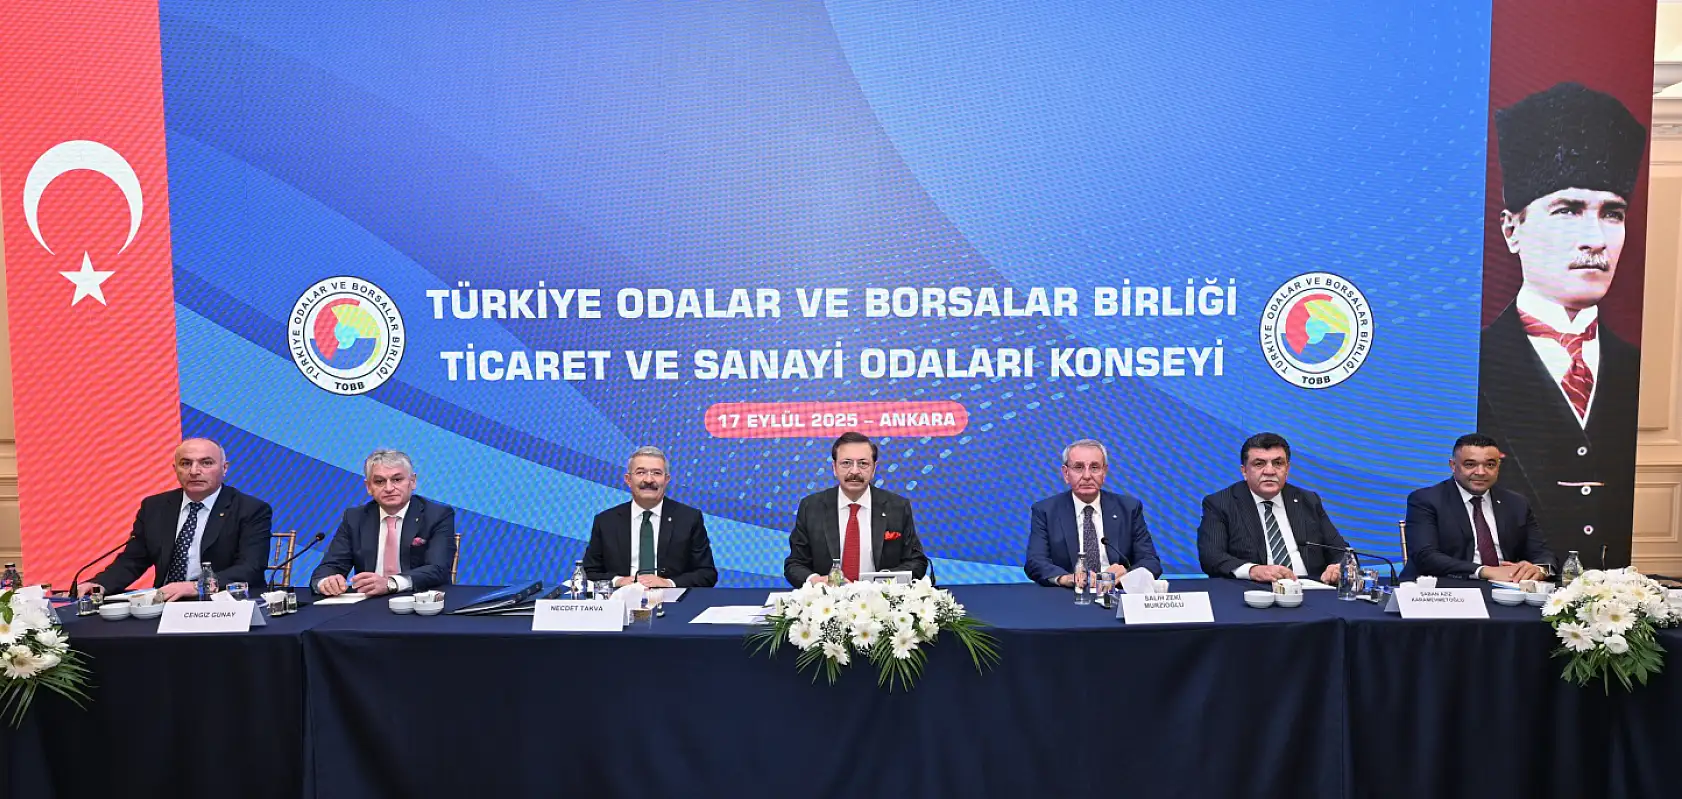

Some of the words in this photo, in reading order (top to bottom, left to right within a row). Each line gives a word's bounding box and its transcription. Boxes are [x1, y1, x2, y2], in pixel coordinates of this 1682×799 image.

[294, 286, 328, 325] ODALAR
[331, 281, 346, 290] VE
[352, 282, 400, 331] BORSALAR
[427, 280, 602, 320] TÜRKİYE
[618, 287, 781, 319] ODALAR
[796, 288, 850, 319] VE
[867, 287, 1079, 319] BORSALAR
[1095, 278, 1238, 317] BİRLİĞİ
[1267, 281, 1302, 320] ODALAR
[1305, 276, 1321, 285] VE
[1325, 277, 1369, 326] BORSALAR
[441, 343, 612, 382] TİCARET
[627, 351, 680, 381] VE
[695, 341, 844, 381] SANAYİ
[861, 349, 1034, 380] ODALARI
[1053, 340, 1225, 379] KONSEYİ
[1302, 375, 1331, 385] TOBB
[334, 381, 365, 391] TOBB
[719, 415, 741, 429] 17
[748, 411, 806, 429] EYLÜL
[812, 414, 859, 428] 2025
[880, 413, 956, 428] ANKARA
